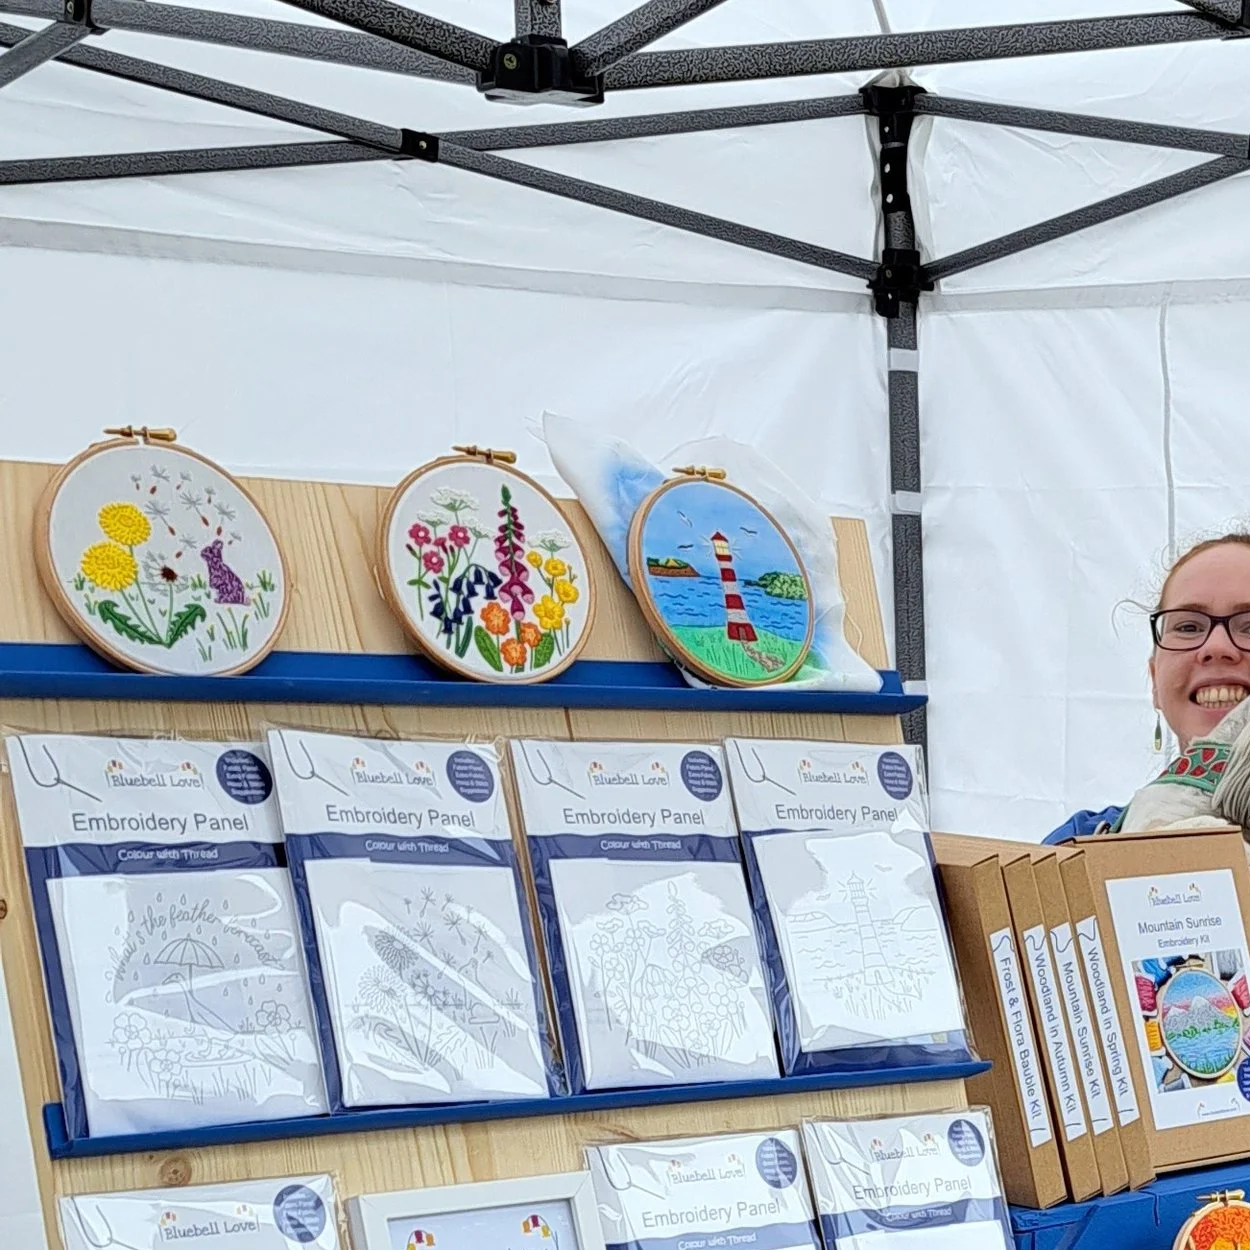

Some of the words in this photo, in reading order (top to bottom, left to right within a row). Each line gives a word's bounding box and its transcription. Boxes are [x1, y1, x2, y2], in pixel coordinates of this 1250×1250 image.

[112, 774, 165, 787] Bluebell
[170, 775, 200, 787] Love
[356, 771, 403, 785] Bluebell
[406, 773, 433, 786] Love
[592, 774, 639, 785] Bluebell
[641, 775, 668, 785] Love
[72, 813, 186, 835] Embroidery
[194, 814, 248, 831] Panel
[326, 804, 422, 828] Embroidery
[429, 809, 475, 827] Panel
[563, 808, 655, 828] Embroidery
[661, 809, 704, 825] Panel
[776, 805, 856, 824] Embroidery
[861, 806, 898, 822] Panel
[118, 850, 153, 861] Colour
[157, 850, 179, 860] with
[181, 849, 218, 859] Thread
[365, 840, 395, 851] Colour
[397, 842, 416, 852] with
[418, 842, 449, 853] Thread
[141, 907, 166, 933] the
[1138, 918, 1184, 934] Mountain
[1186, 916, 1222, 929] Sunrise
[1158, 938, 1199, 949] Embroidery
[1199, 934, 1210, 944] Kit
[1000, 957, 1015, 994] Frost
[1088, 947, 1110, 1017] Woodland
[1034, 952, 1056, 1022] Woodland
[1008, 996, 1019, 1010] &
[1012, 1010, 1025, 1048] Flora
[1050, 1024, 1060, 1038] in
[1064, 962, 1082, 1026] Mountain
[1078, 1026, 1096, 1077] Sunrise
[1089, 1080, 1100, 1100] Kit
[1103, 1017, 1112, 1031] in
[1107, 1032, 1123, 1075] Spring
[1020, 1048, 1036, 1097] Bauble
[1053, 1040, 1071, 1094] Autumn
[1118, 1077, 1128, 1098] Kit
[1030, 1100, 1042, 1120] Kit
[1066, 1096, 1078, 1114] Kit
[671, 1172, 715, 1184] Bluebell
[719, 1168, 743, 1180] Love
[853, 1183, 930, 1200] Embroidery
[935, 1176, 971, 1194] Panel
[642, 1206, 732, 1228] Embroidery
[737, 1198, 780, 1217] Panel
[165, 1224, 219, 1240] Bluebell
[224, 1220, 256, 1233] Love
